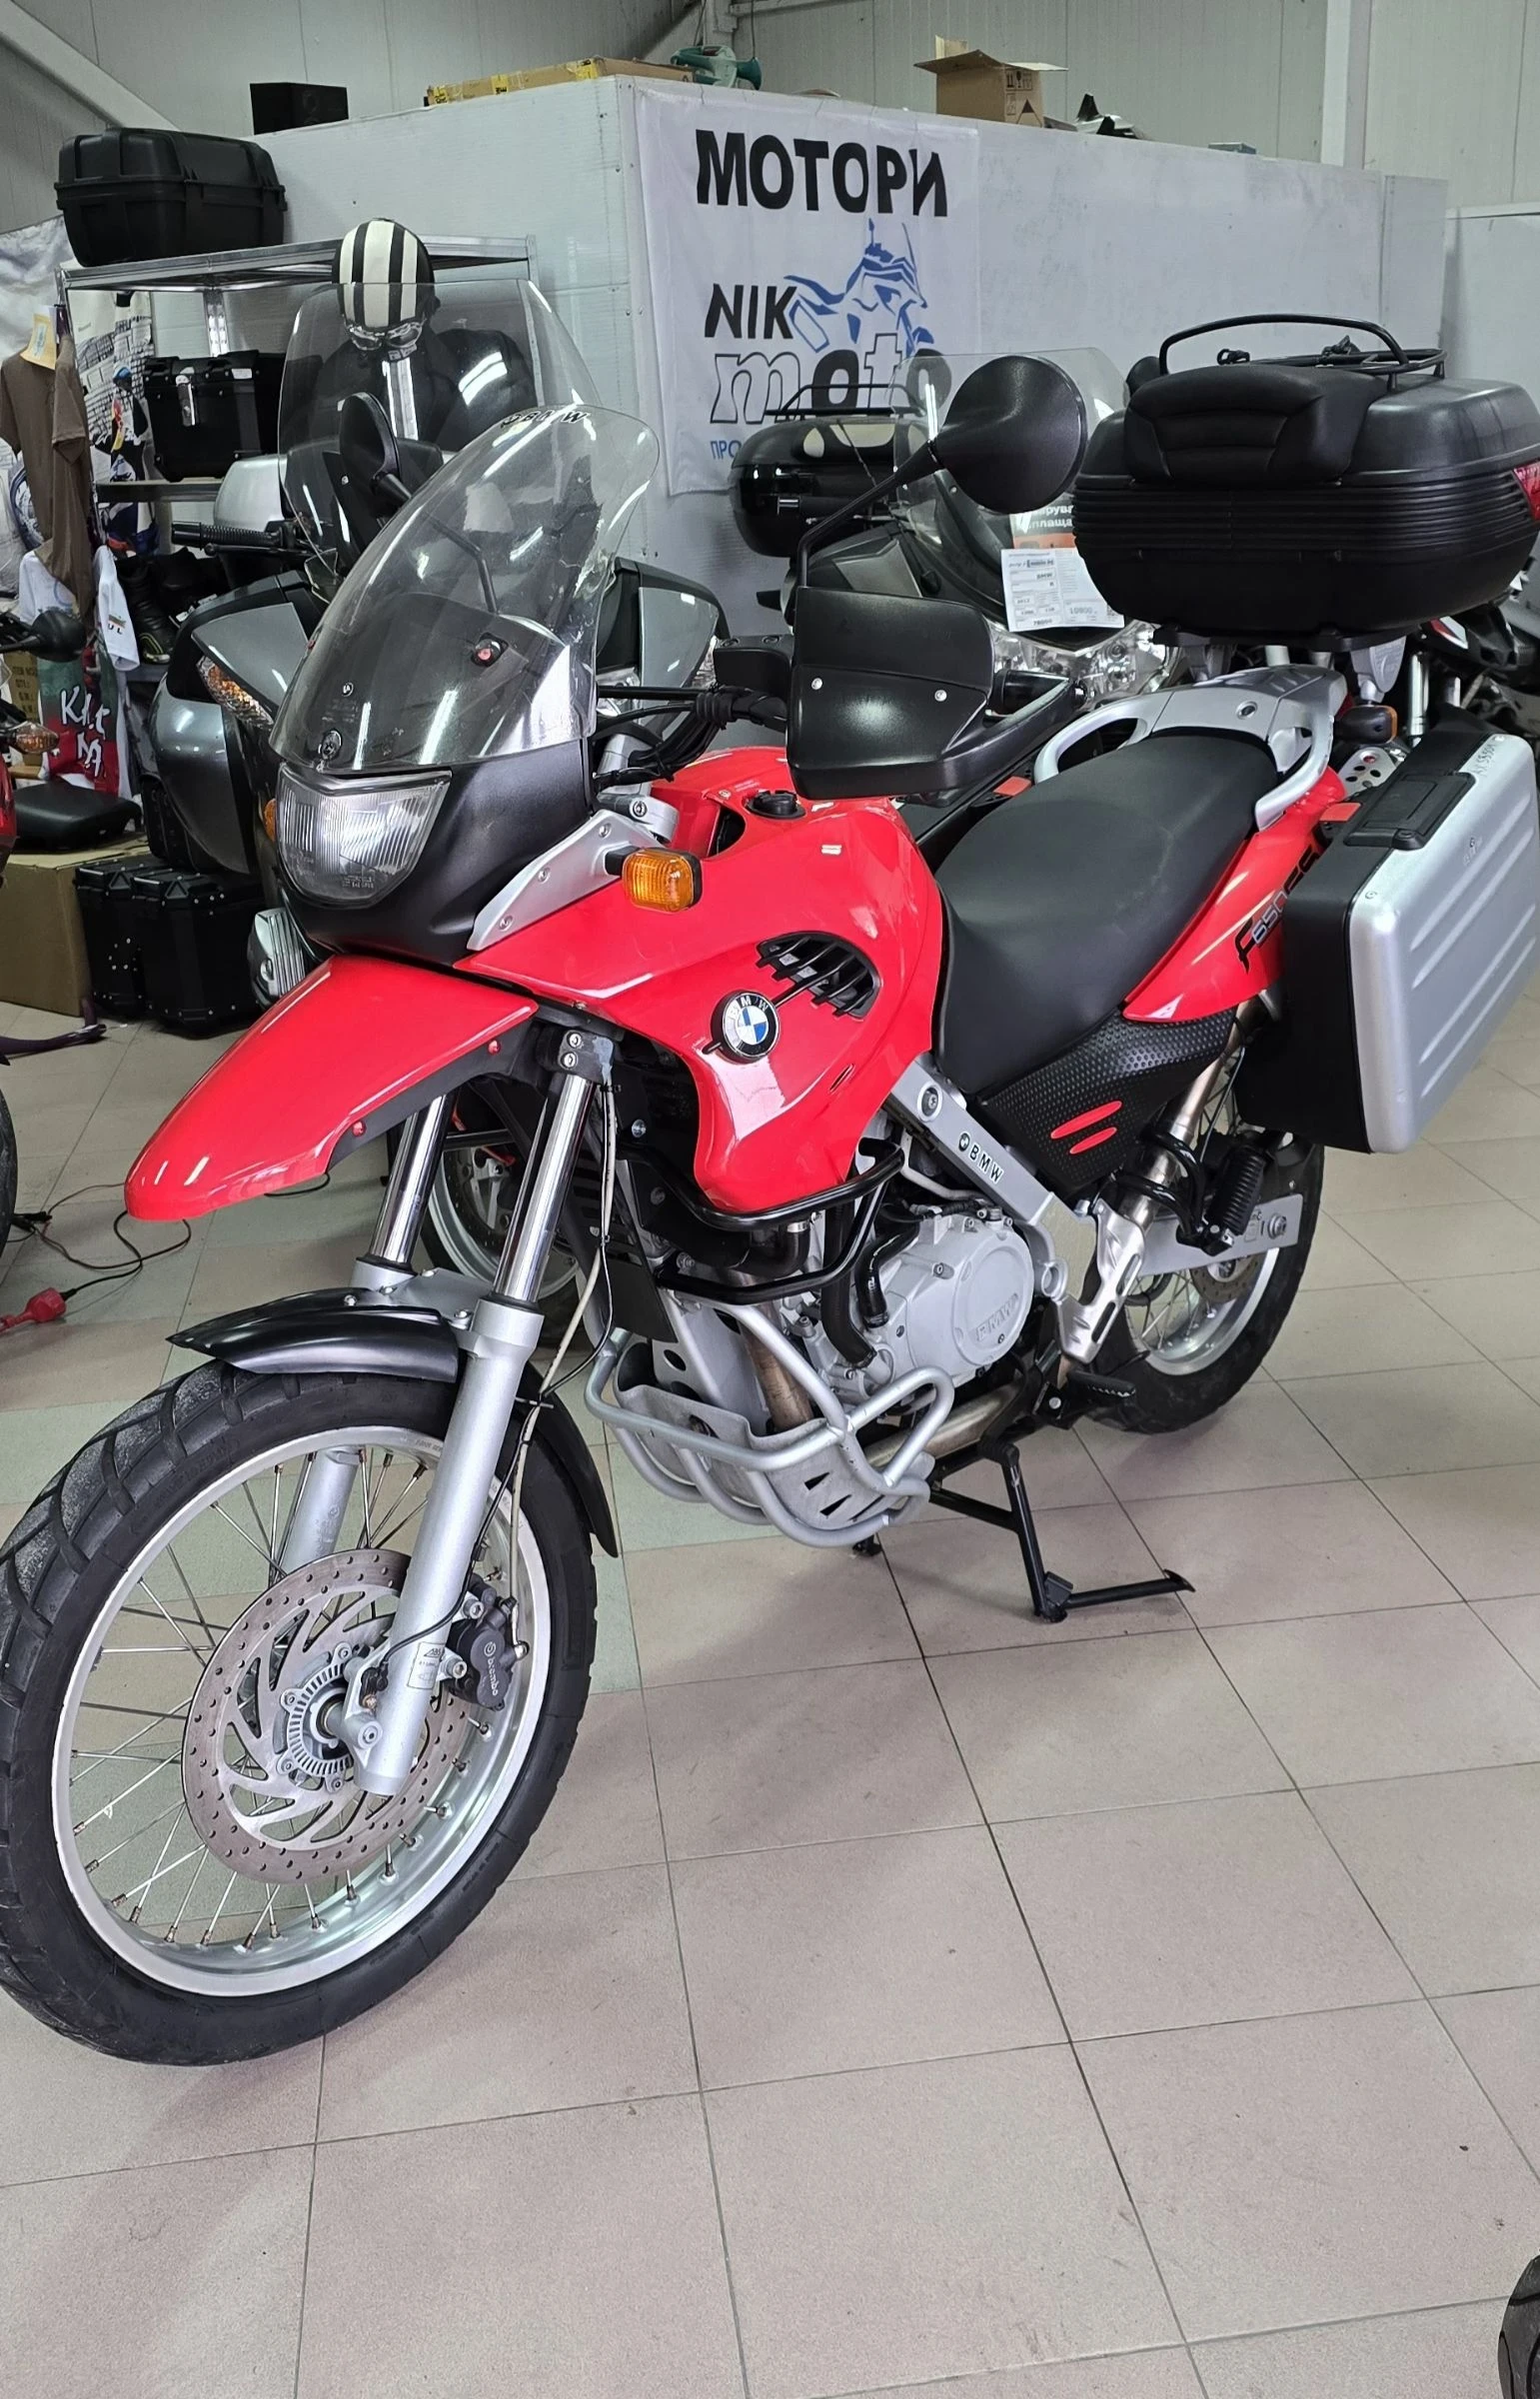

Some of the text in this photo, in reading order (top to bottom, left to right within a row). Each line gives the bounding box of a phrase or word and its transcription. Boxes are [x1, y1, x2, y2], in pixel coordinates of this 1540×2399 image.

[696, 129, 947, 217] МОТОРИ
[705, 283, 797, 339] NIK
[969, 1144, 1004, 1183] BMW
[488, 1656, 499, 1696] brembo
